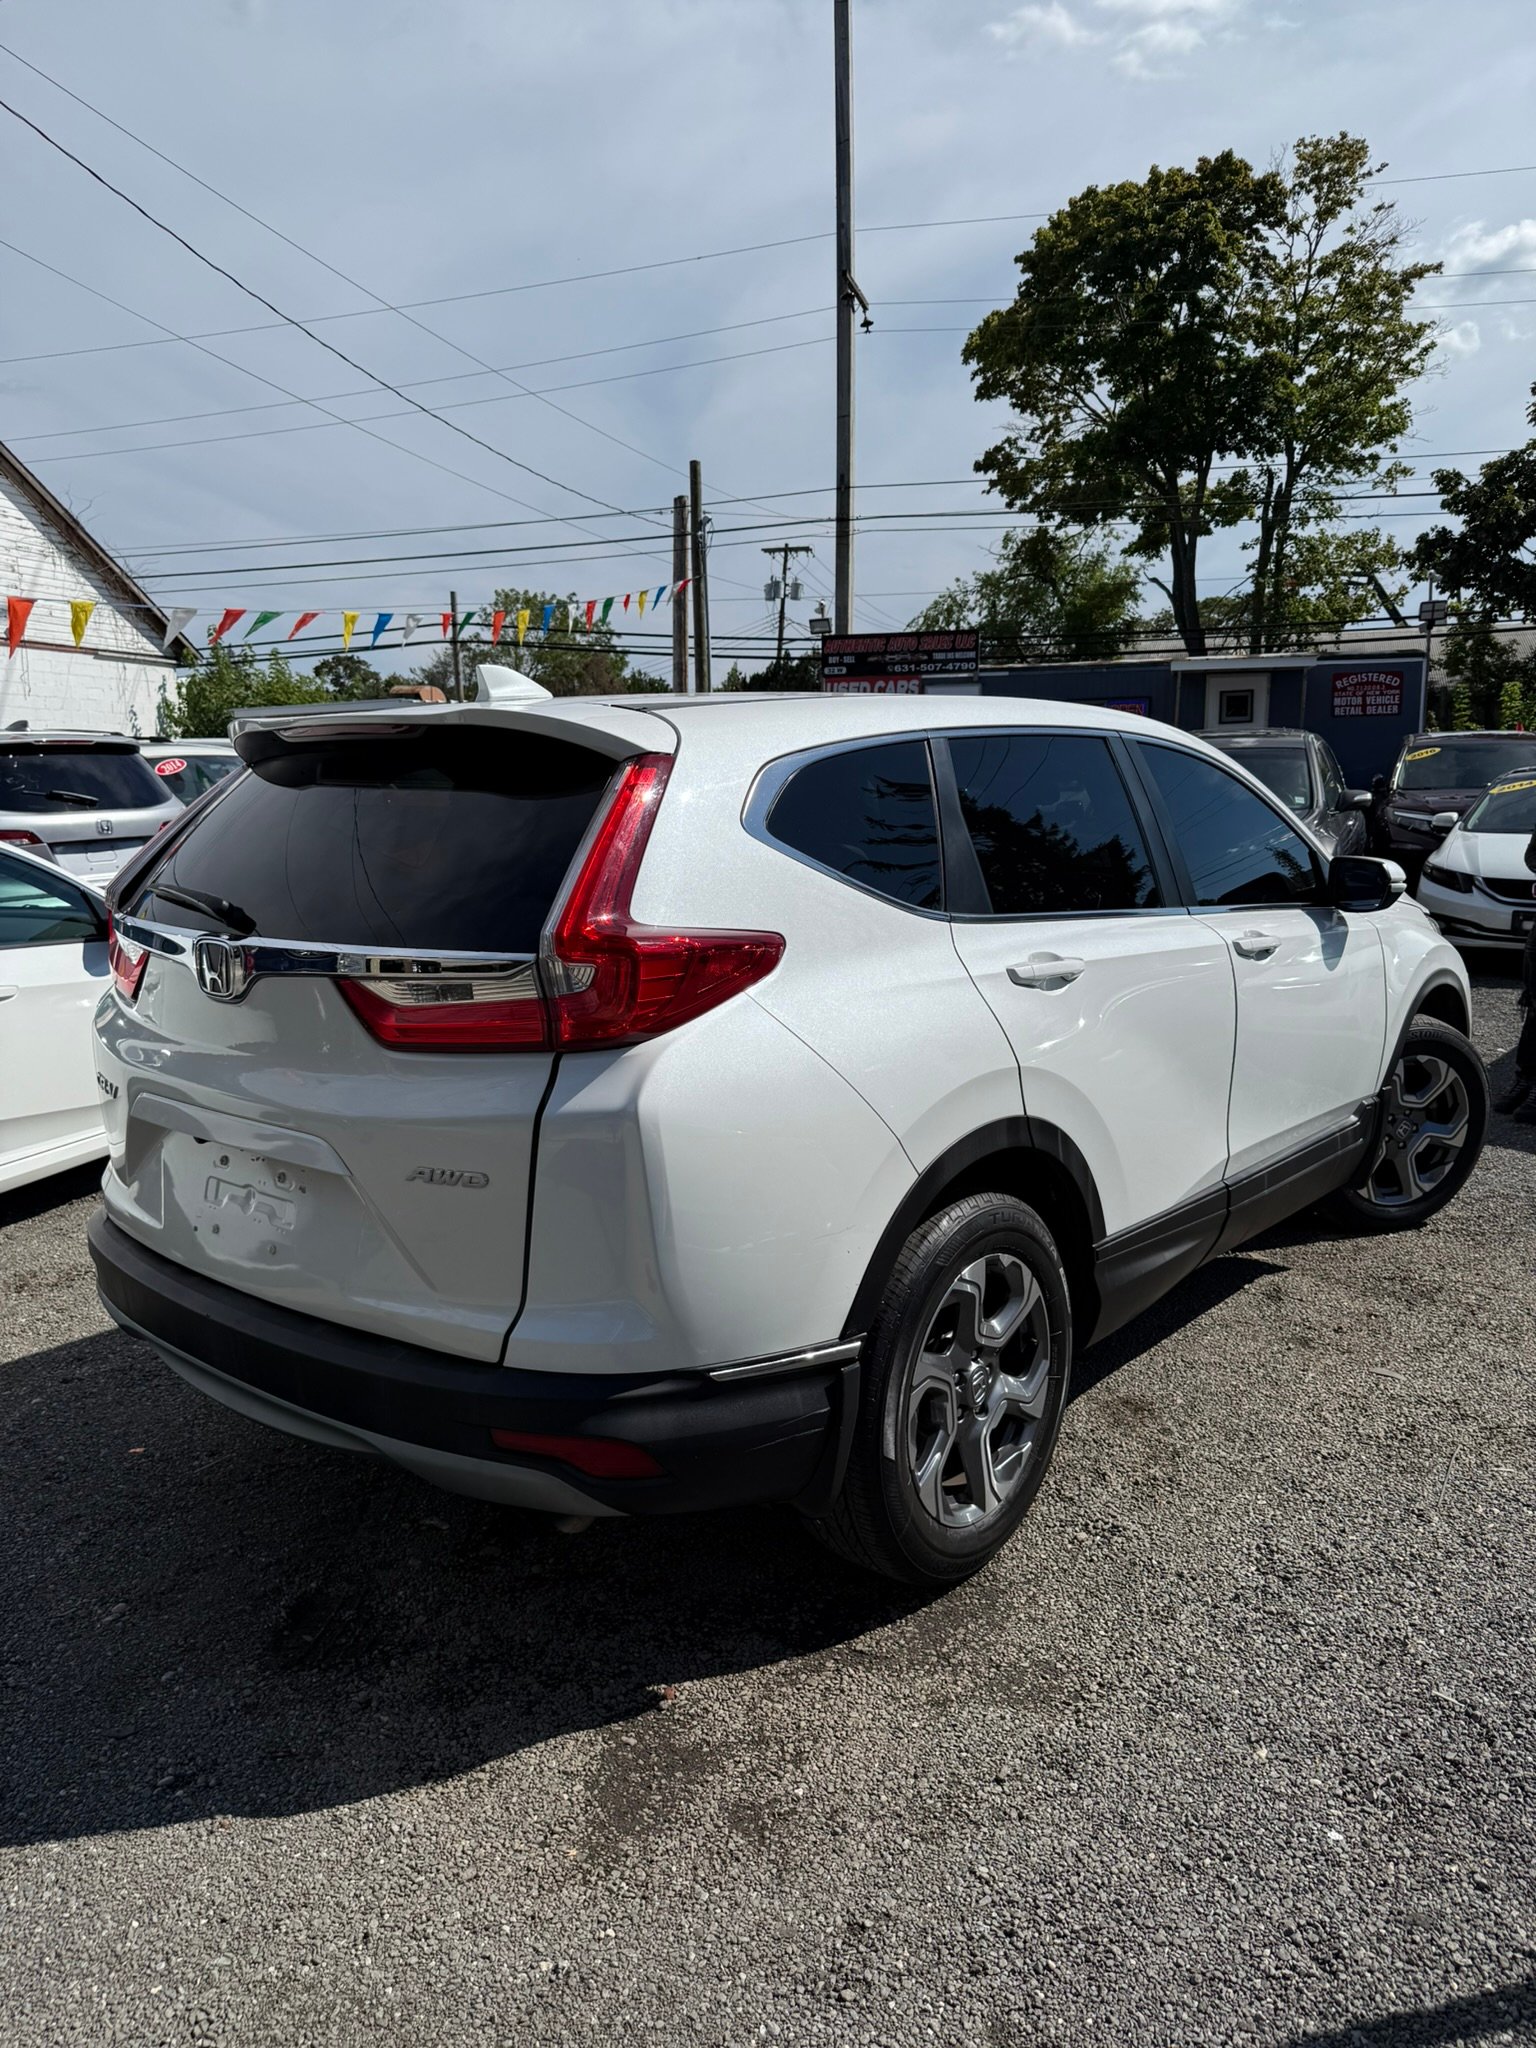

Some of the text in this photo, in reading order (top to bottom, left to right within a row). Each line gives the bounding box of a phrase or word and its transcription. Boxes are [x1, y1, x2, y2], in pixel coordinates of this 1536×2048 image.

[824, 633, 977, 654] AUTHENTIC AUTO SALES LLC
[843, 655, 855, 664] SELL
[894, 661, 977, 673] 631-507-4790
[873, 679, 920, 694] CARS
[1335, 672, 1401, 689] REGISTERED
[1333, 695, 1400, 706] MOTOR VEHICLE
[1334, 705, 1399, 716] RETAIL DEALER
[162, 760, 181, 774] 2014
[404, 1166, 490, 1189] AWD
